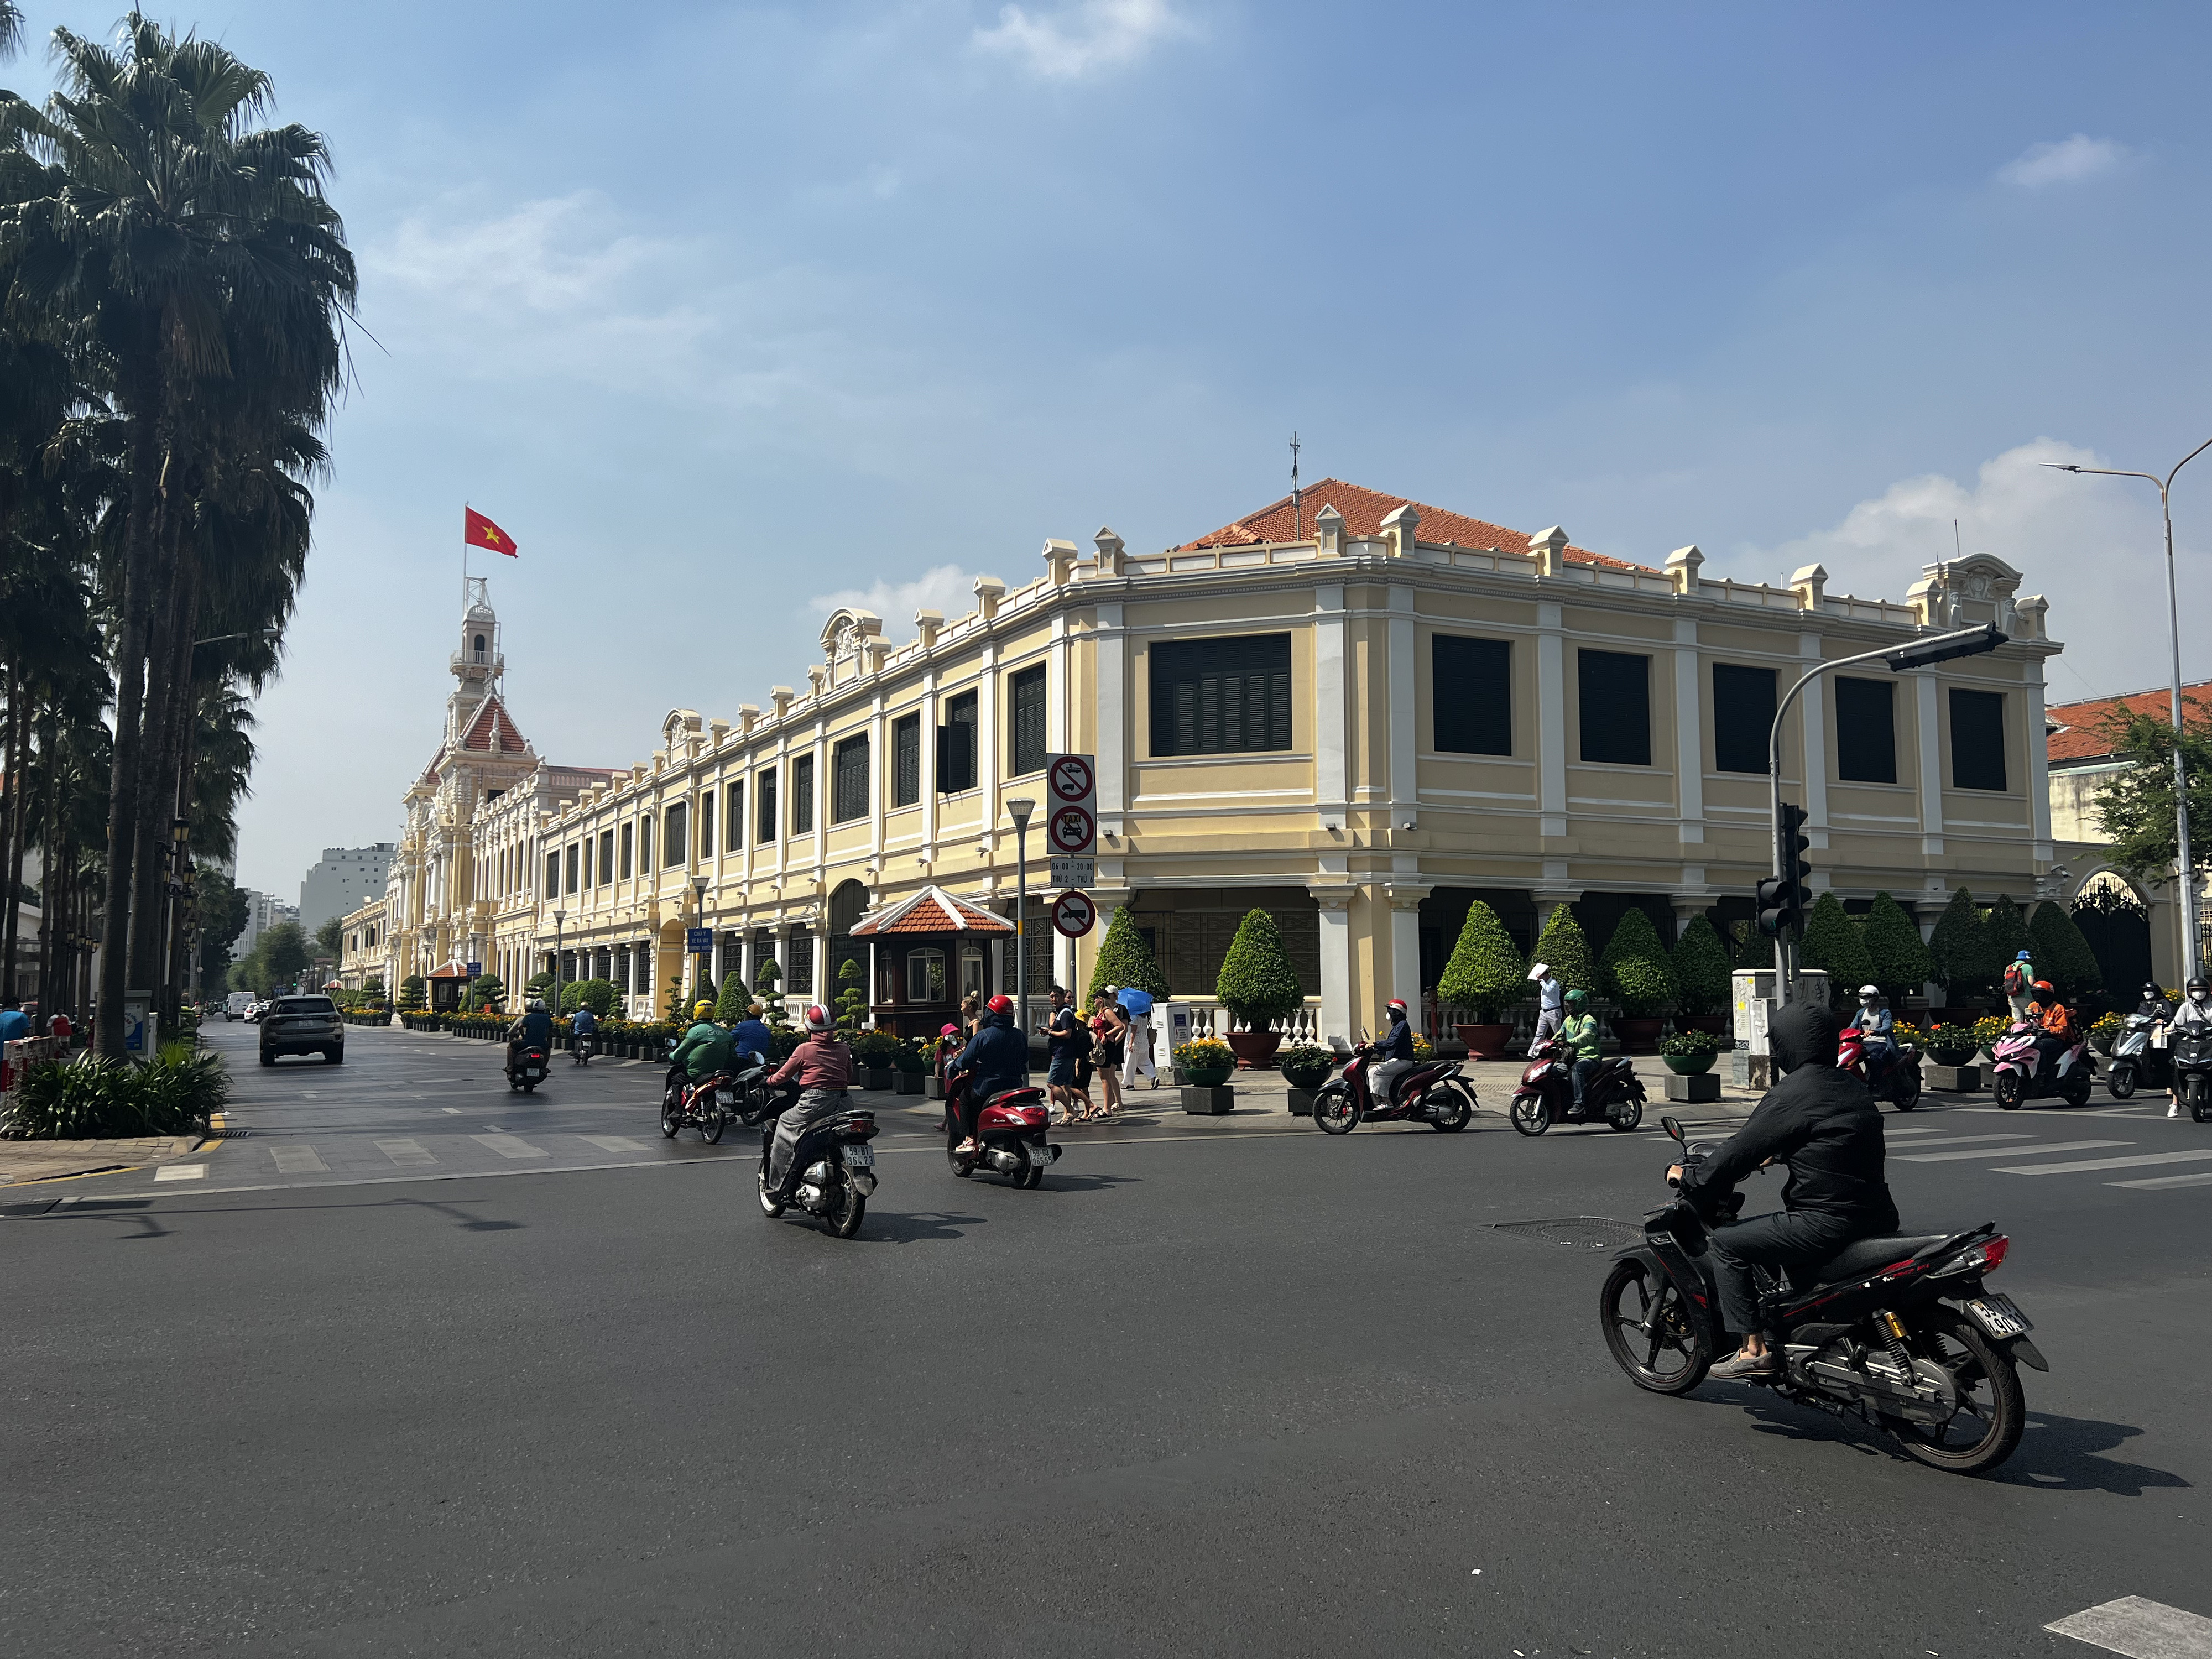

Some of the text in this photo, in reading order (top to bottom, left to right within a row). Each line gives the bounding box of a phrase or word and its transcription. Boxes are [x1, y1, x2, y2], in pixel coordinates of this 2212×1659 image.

[1063, 815, 1081, 823] TAXI
[1052, 874, 1062, 883] THỨ
[1077, 874, 1087, 883] THỨ
[849, 1146, 868, 1155] 59-B1
